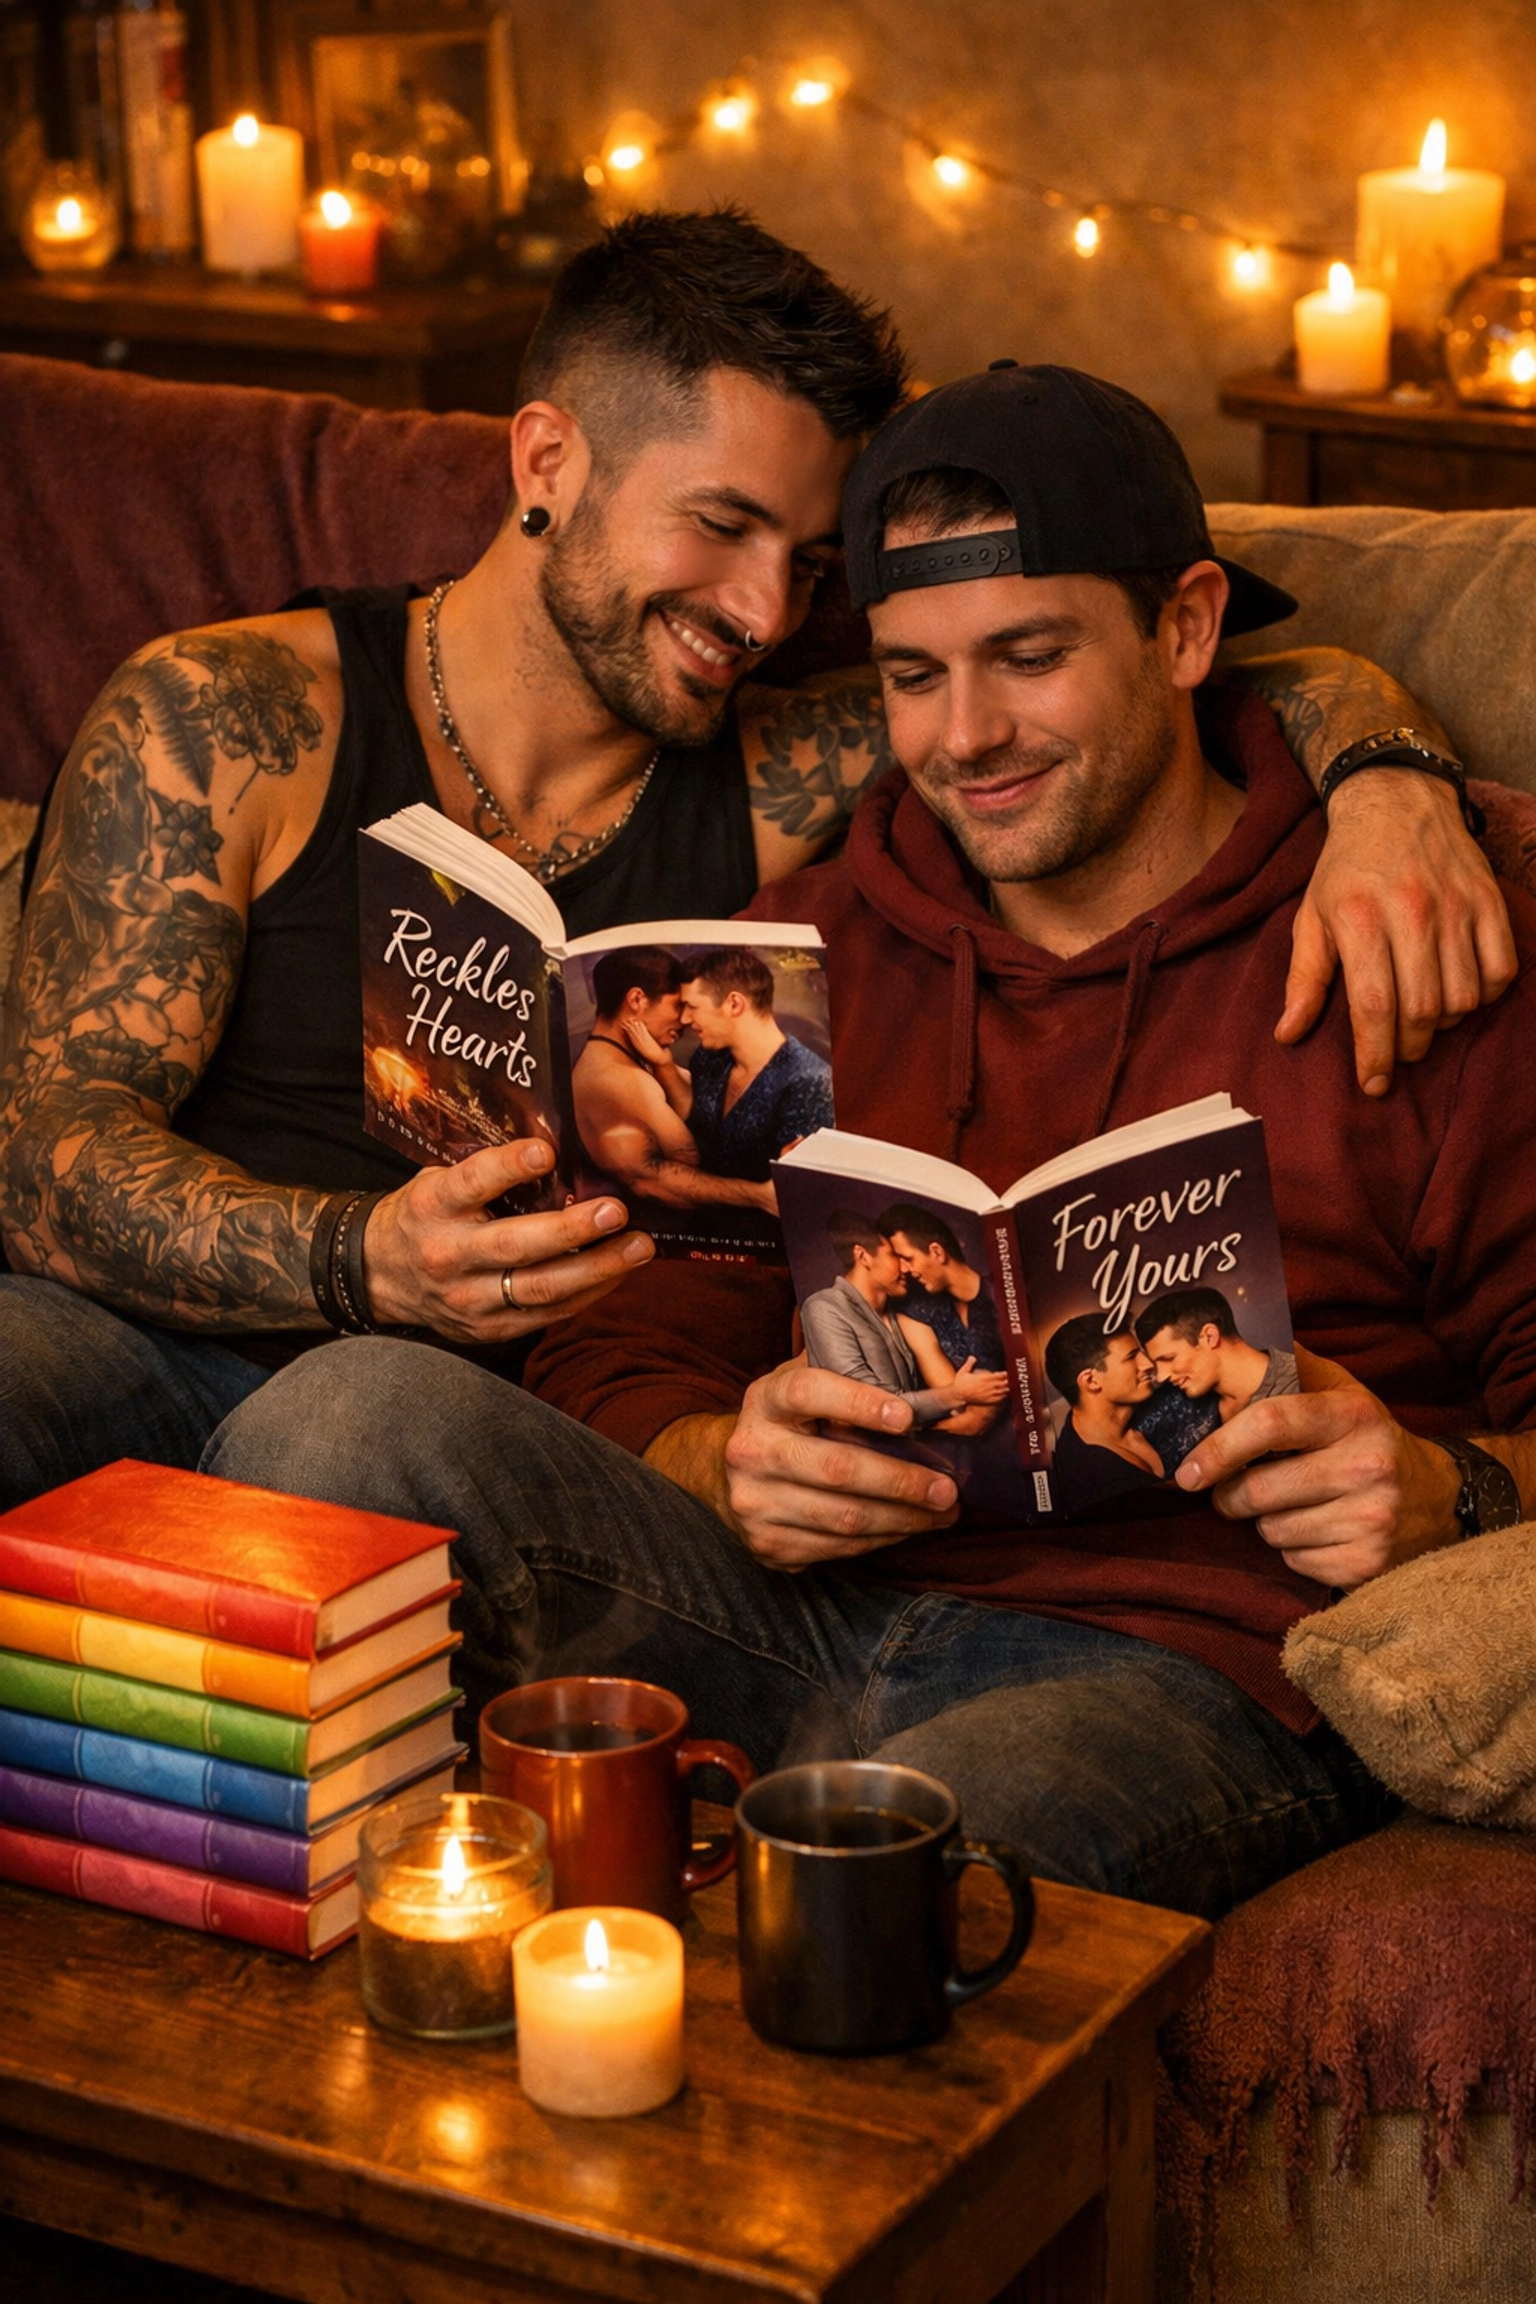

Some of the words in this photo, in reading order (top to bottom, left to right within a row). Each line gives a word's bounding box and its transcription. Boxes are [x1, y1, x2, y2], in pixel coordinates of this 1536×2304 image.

[384, 908, 536, 1021] Reckles
[406, 984, 537, 1088] Hearts
[1053, 1169, 1242, 1271] Forever
[1092, 1232, 1242, 1335] Yours
